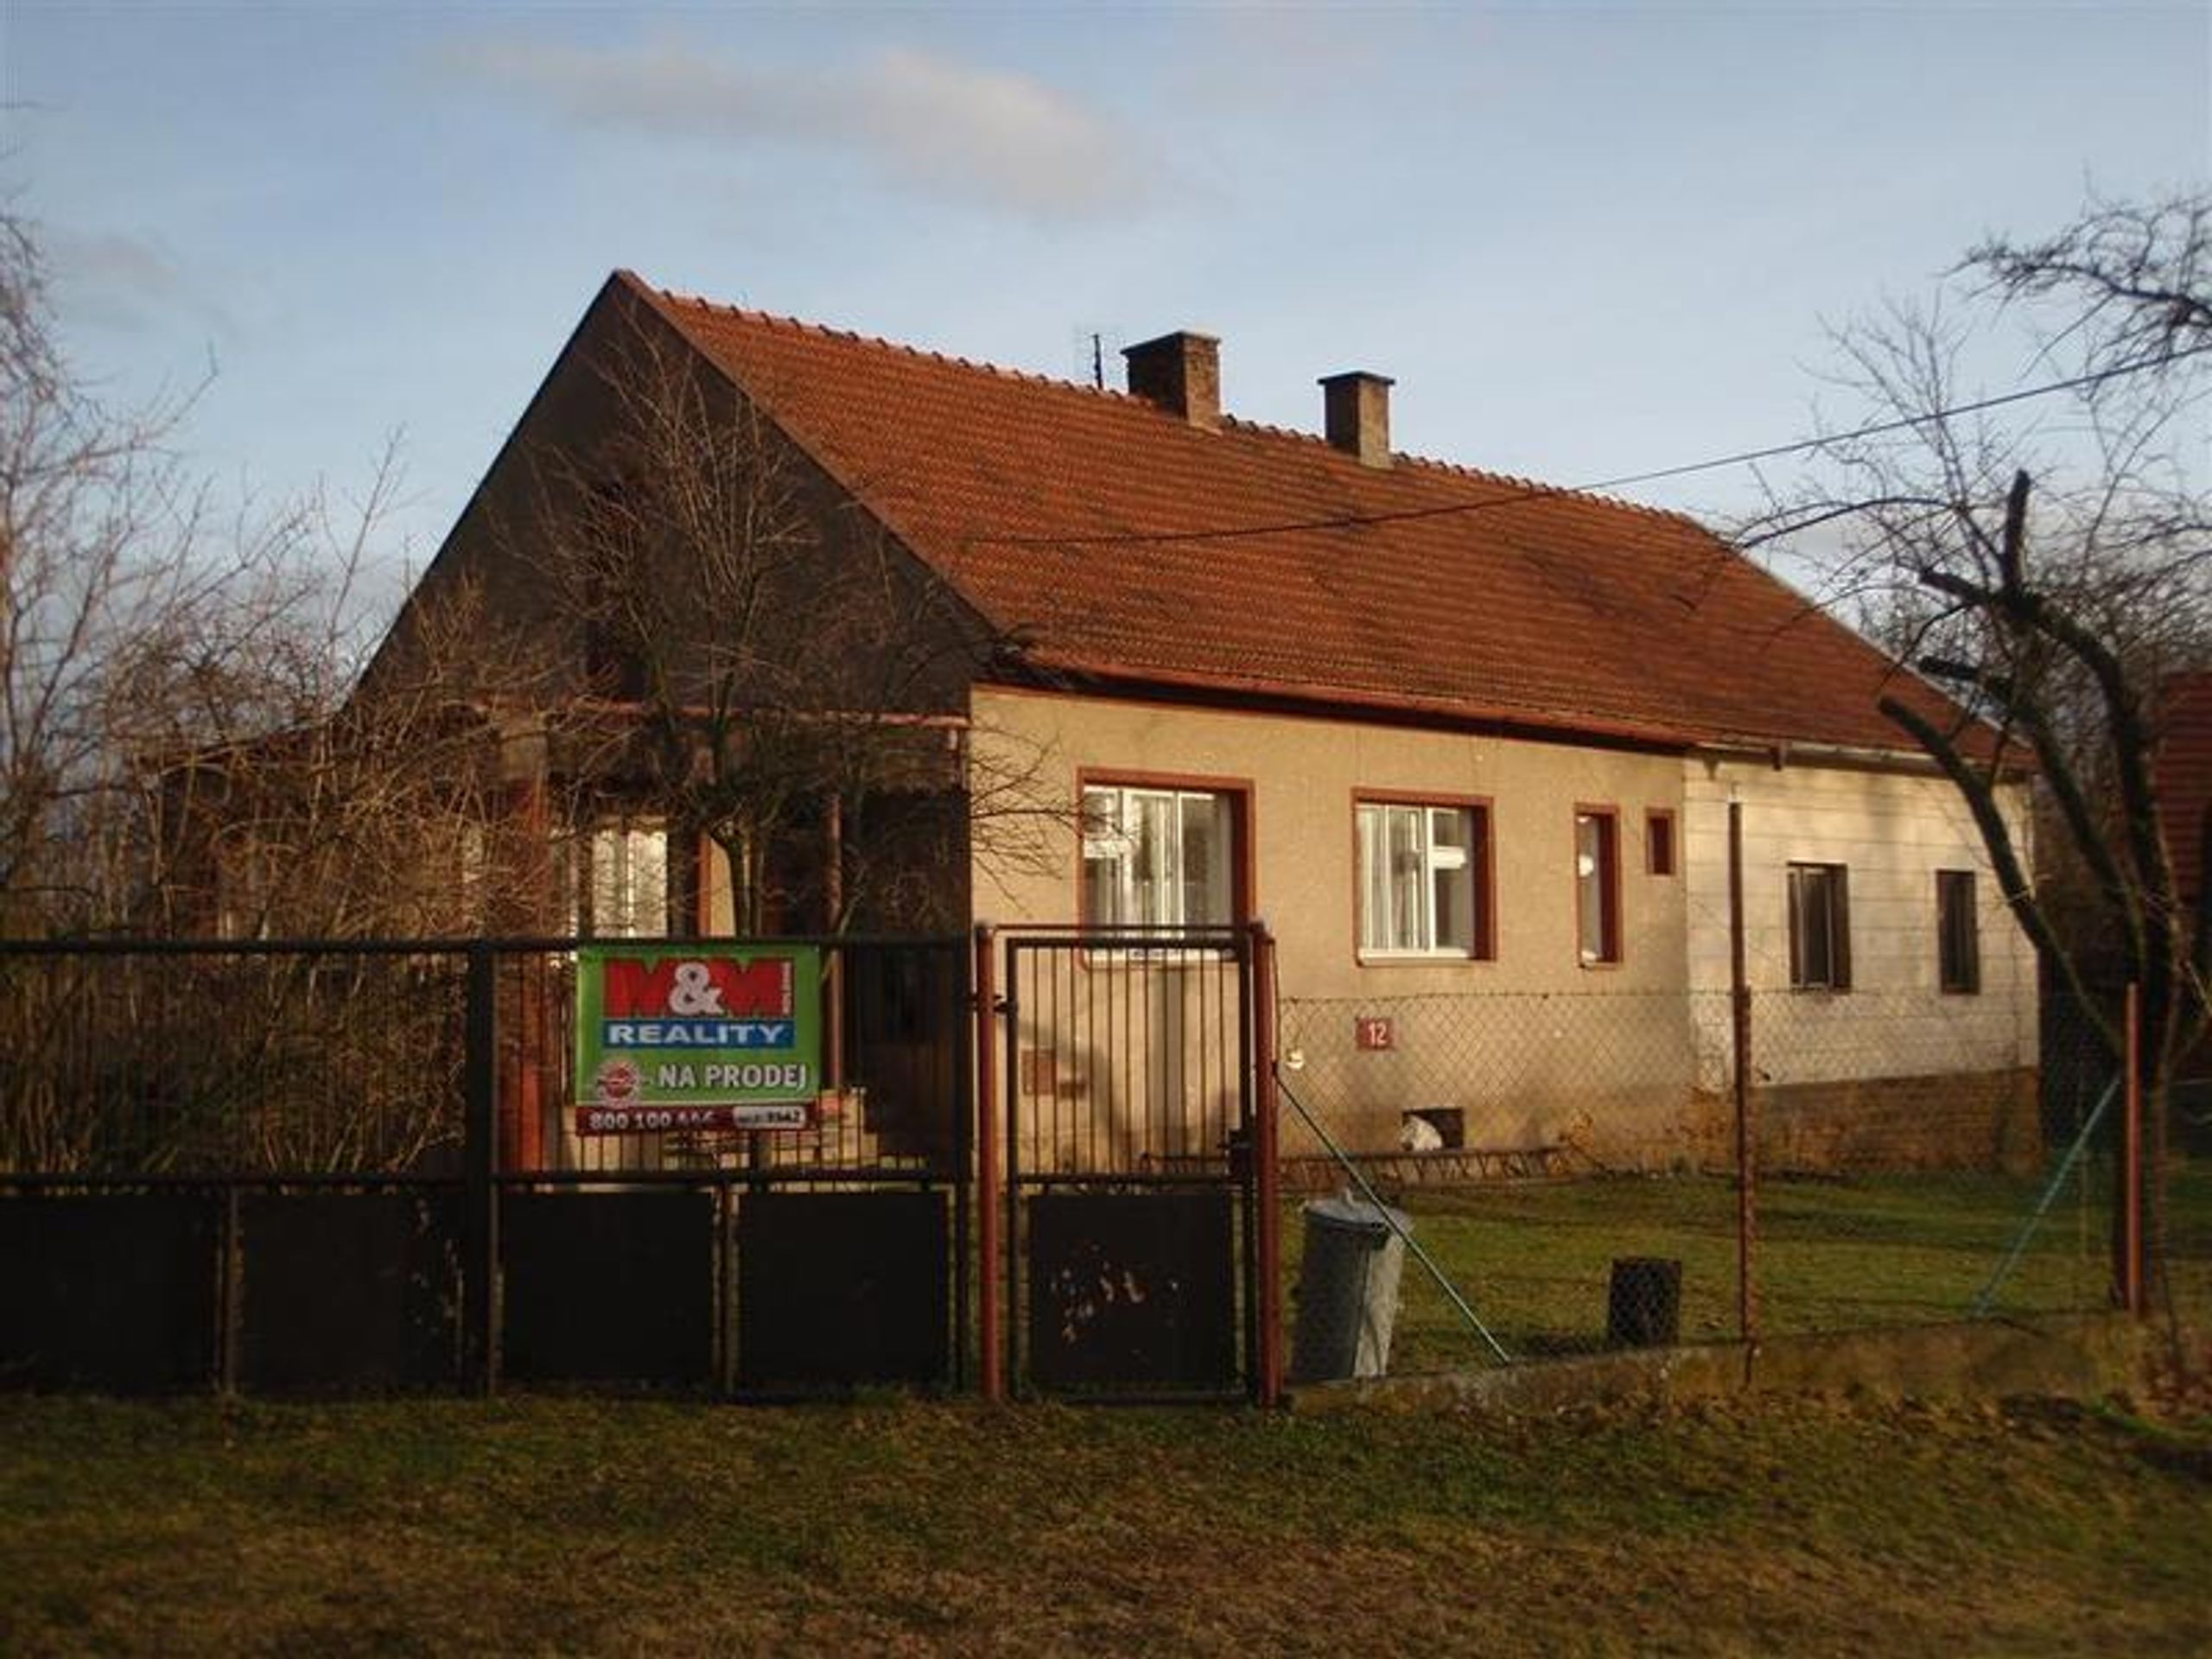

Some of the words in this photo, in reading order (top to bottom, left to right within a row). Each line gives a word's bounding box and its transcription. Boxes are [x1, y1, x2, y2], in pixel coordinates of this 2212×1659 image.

[603, 957, 793, 1017] M&M
[608, 1025, 784, 1044] REALITY
[1369, 1022, 1387, 1045] 12
[658, 1065, 693, 1088] NA
[706, 1065, 806, 1090] PRODEJ
[589, 1112, 628, 1129] 800
[635, 1111, 671, 1128] 100
